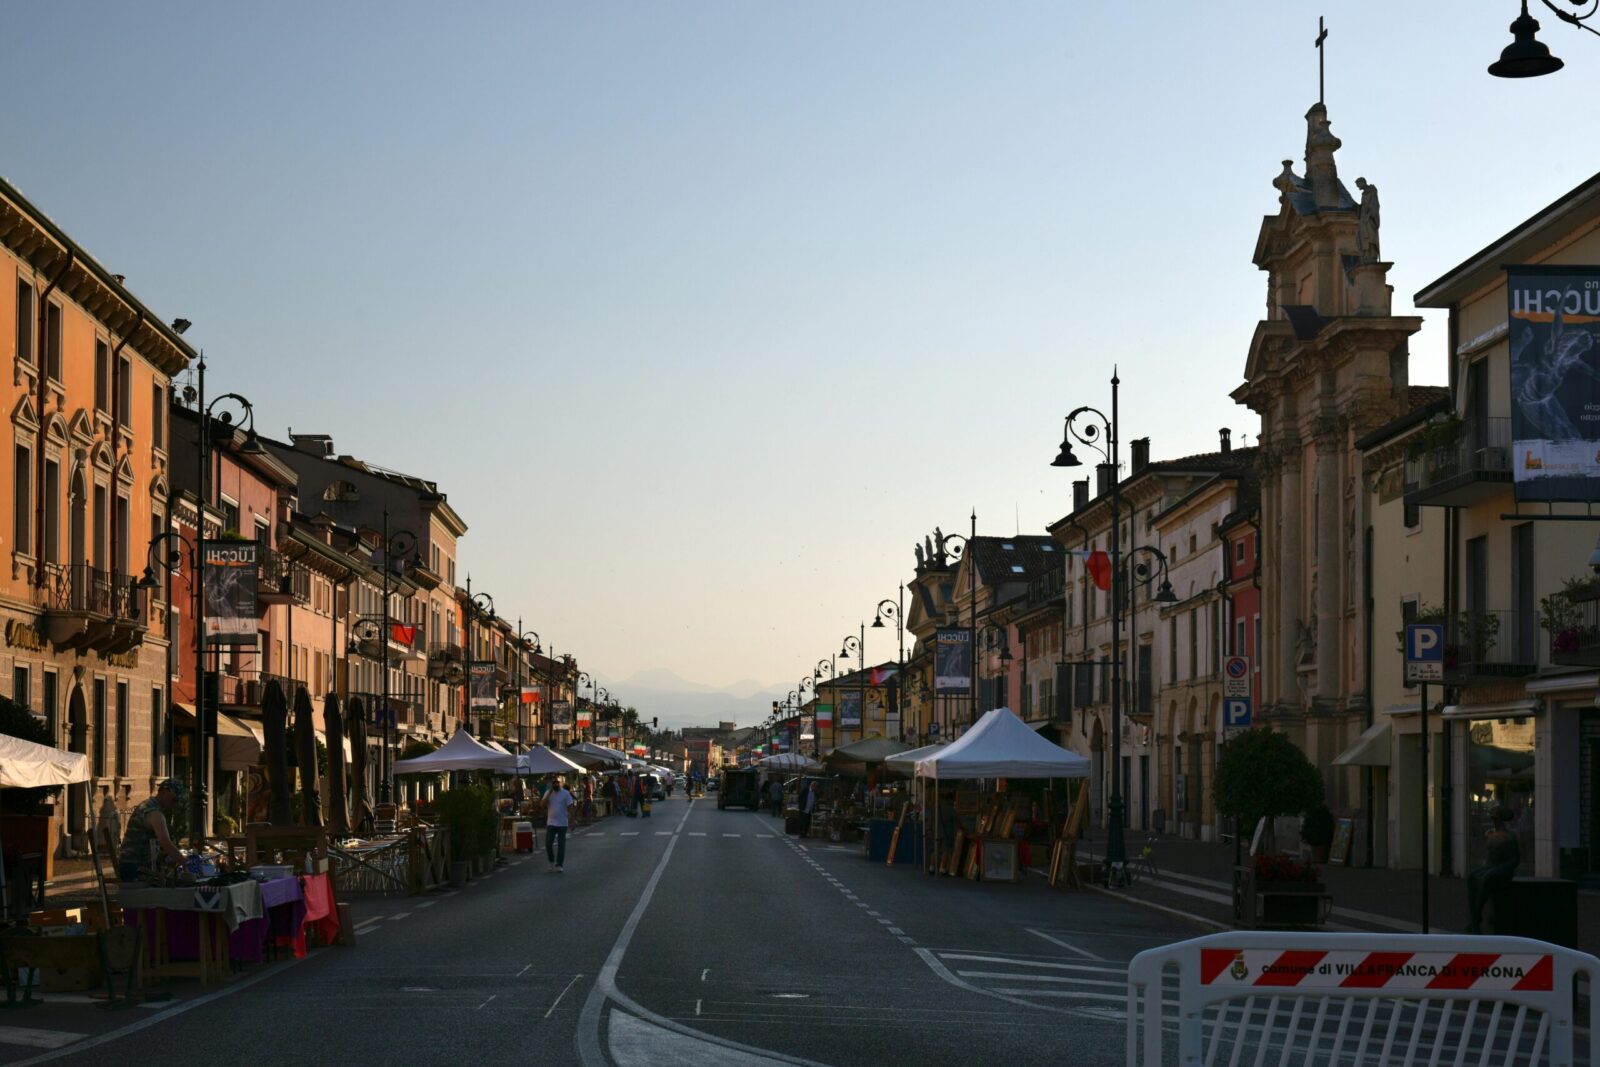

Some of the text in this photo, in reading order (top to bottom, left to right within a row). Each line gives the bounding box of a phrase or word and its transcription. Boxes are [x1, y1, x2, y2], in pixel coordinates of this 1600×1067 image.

[1414, 628, 1438, 659] P
[1229, 701, 1247, 724] P
[1261, 963, 1525, 979] comune di VILLAFRANCA DI VERONA
